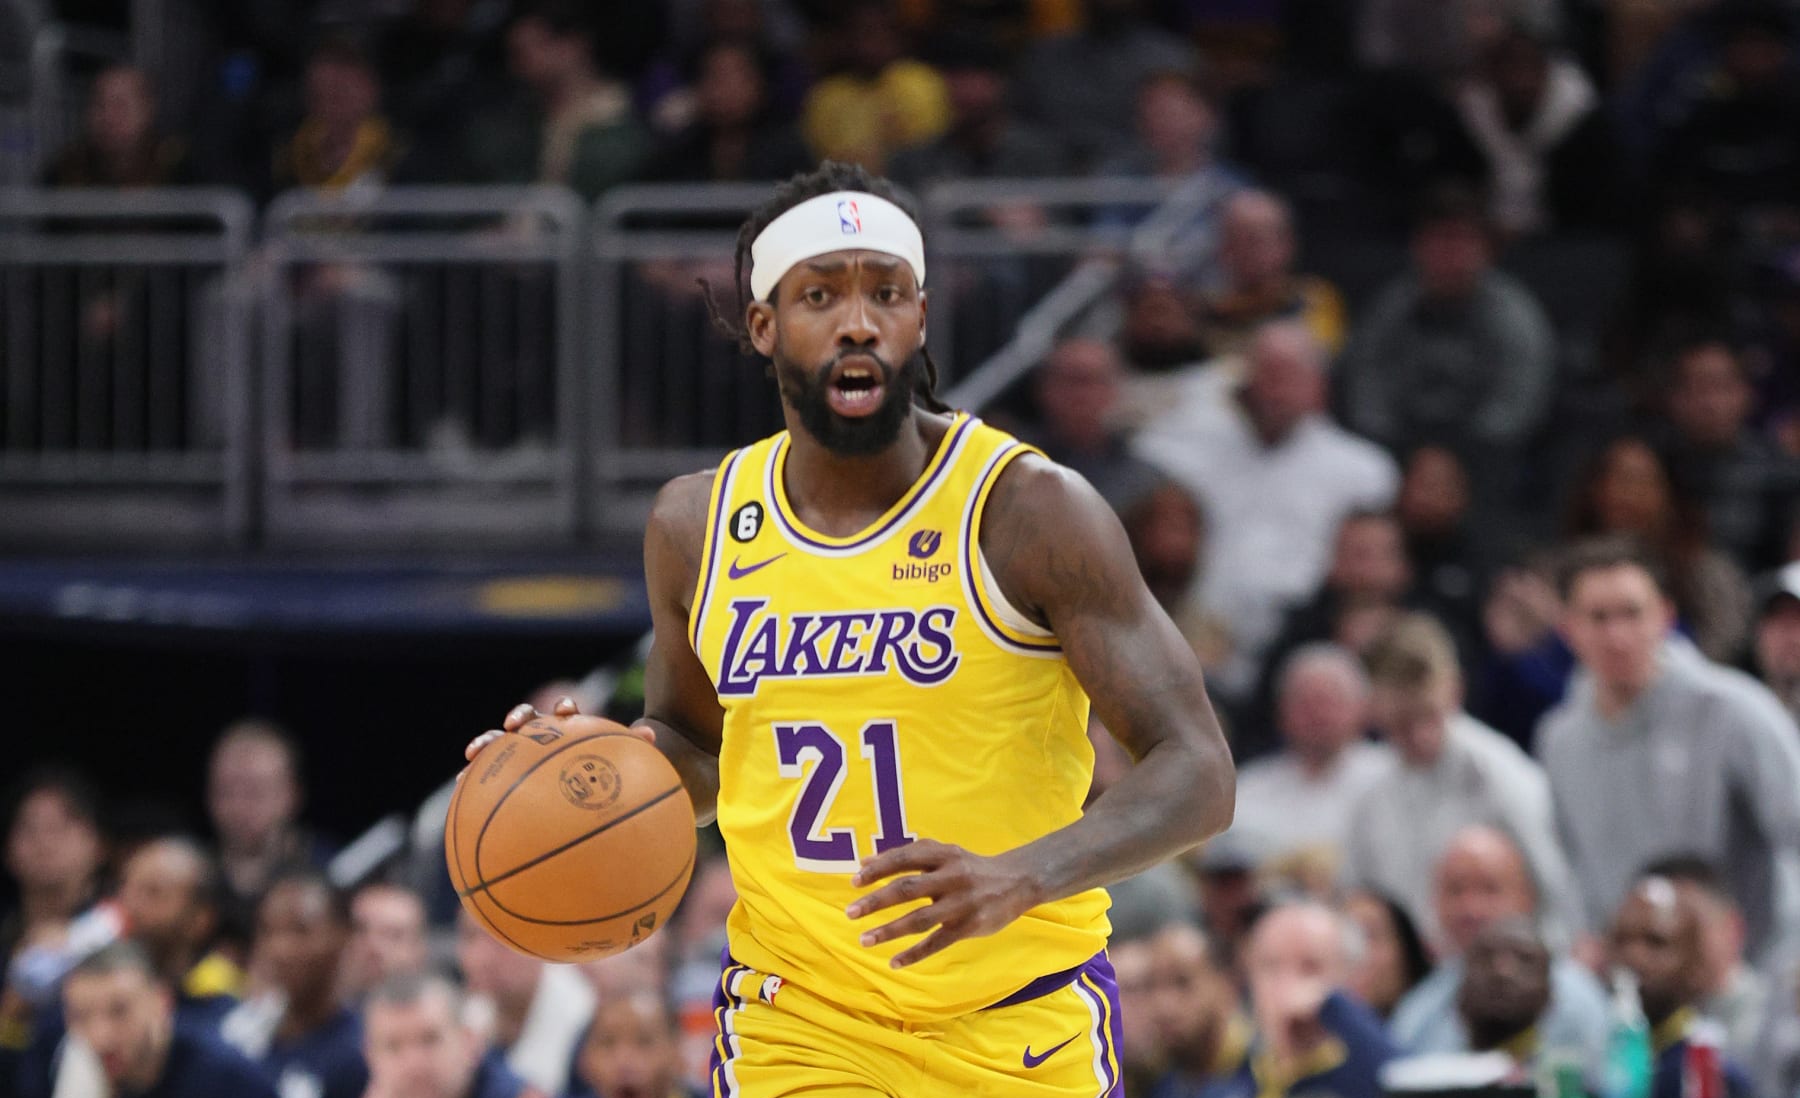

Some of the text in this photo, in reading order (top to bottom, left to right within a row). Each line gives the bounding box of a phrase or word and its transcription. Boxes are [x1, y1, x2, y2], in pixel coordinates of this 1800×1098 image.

[736, 505, 759, 541] 6
[891, 562, 952, 583] bibigo
[717, 598, 961, 695] LAKERS
[771, 719, 917, 873] 21
